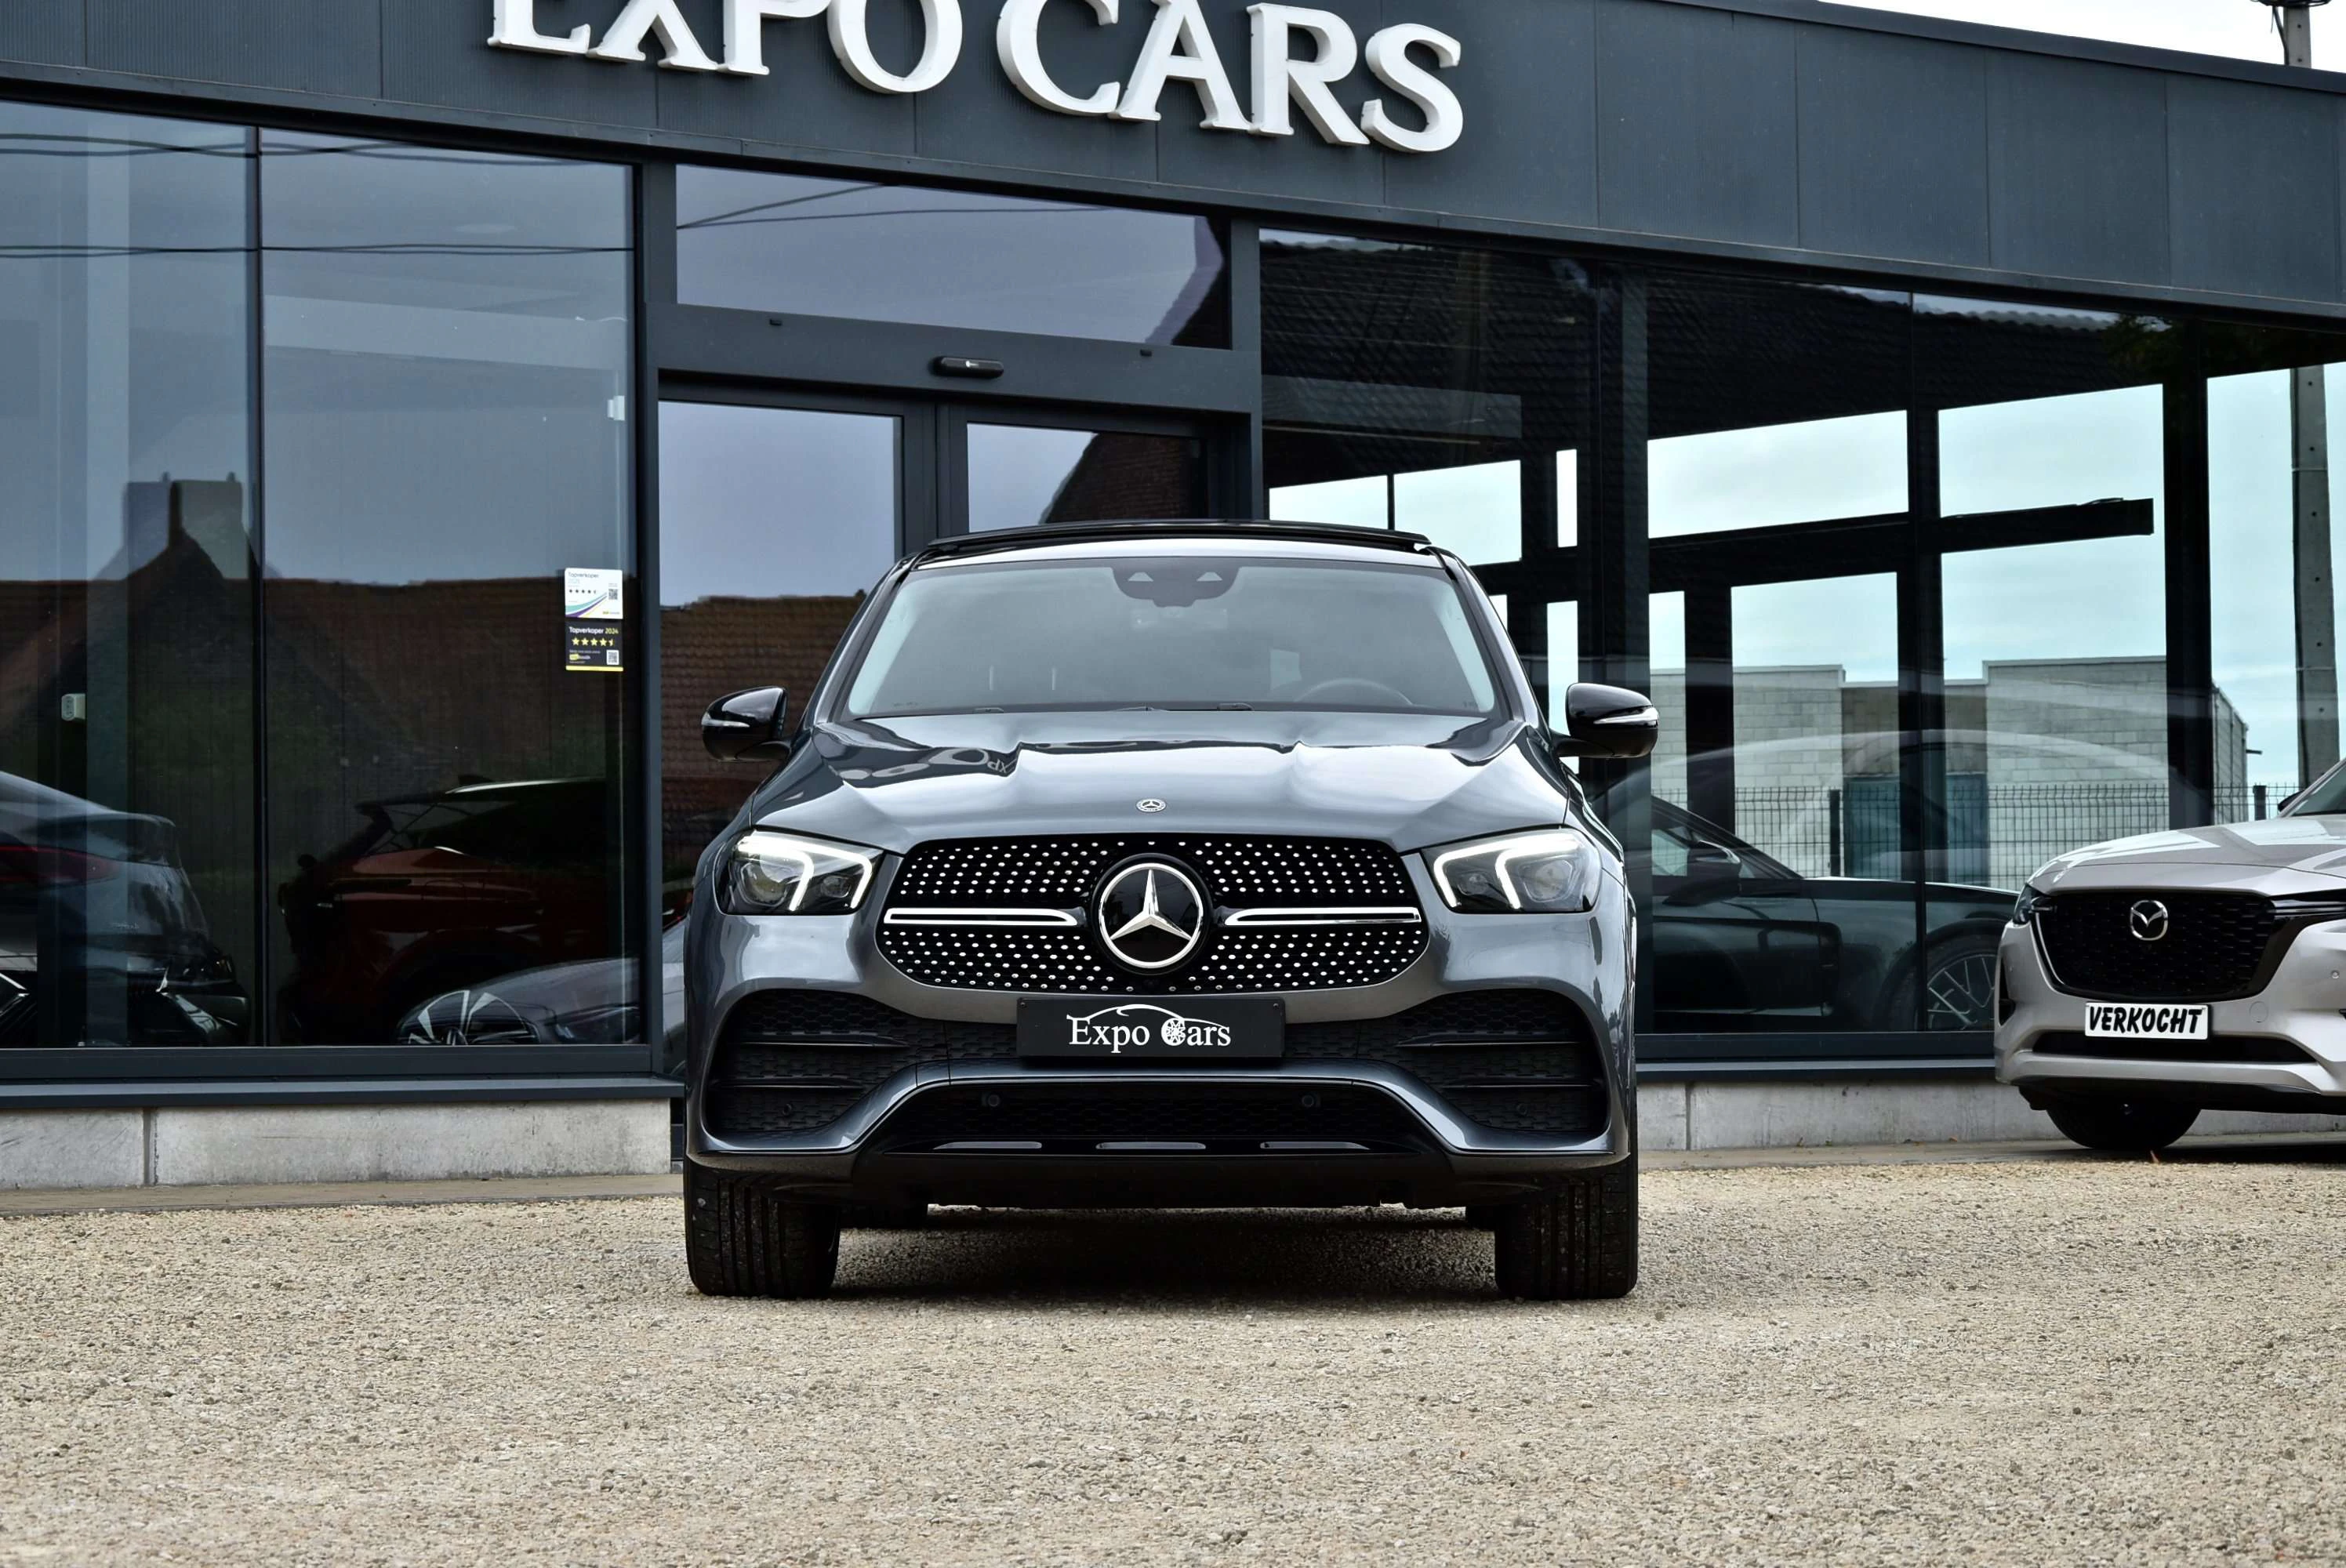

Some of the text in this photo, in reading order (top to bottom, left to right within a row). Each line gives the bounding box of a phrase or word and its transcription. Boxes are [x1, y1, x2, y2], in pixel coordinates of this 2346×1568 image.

[996, 0, 1464, 152] CARS
[1068, 1018, 1231, 1053] Expo Cars
[2090, 1006, 2203, 1034] VERKOCHT
